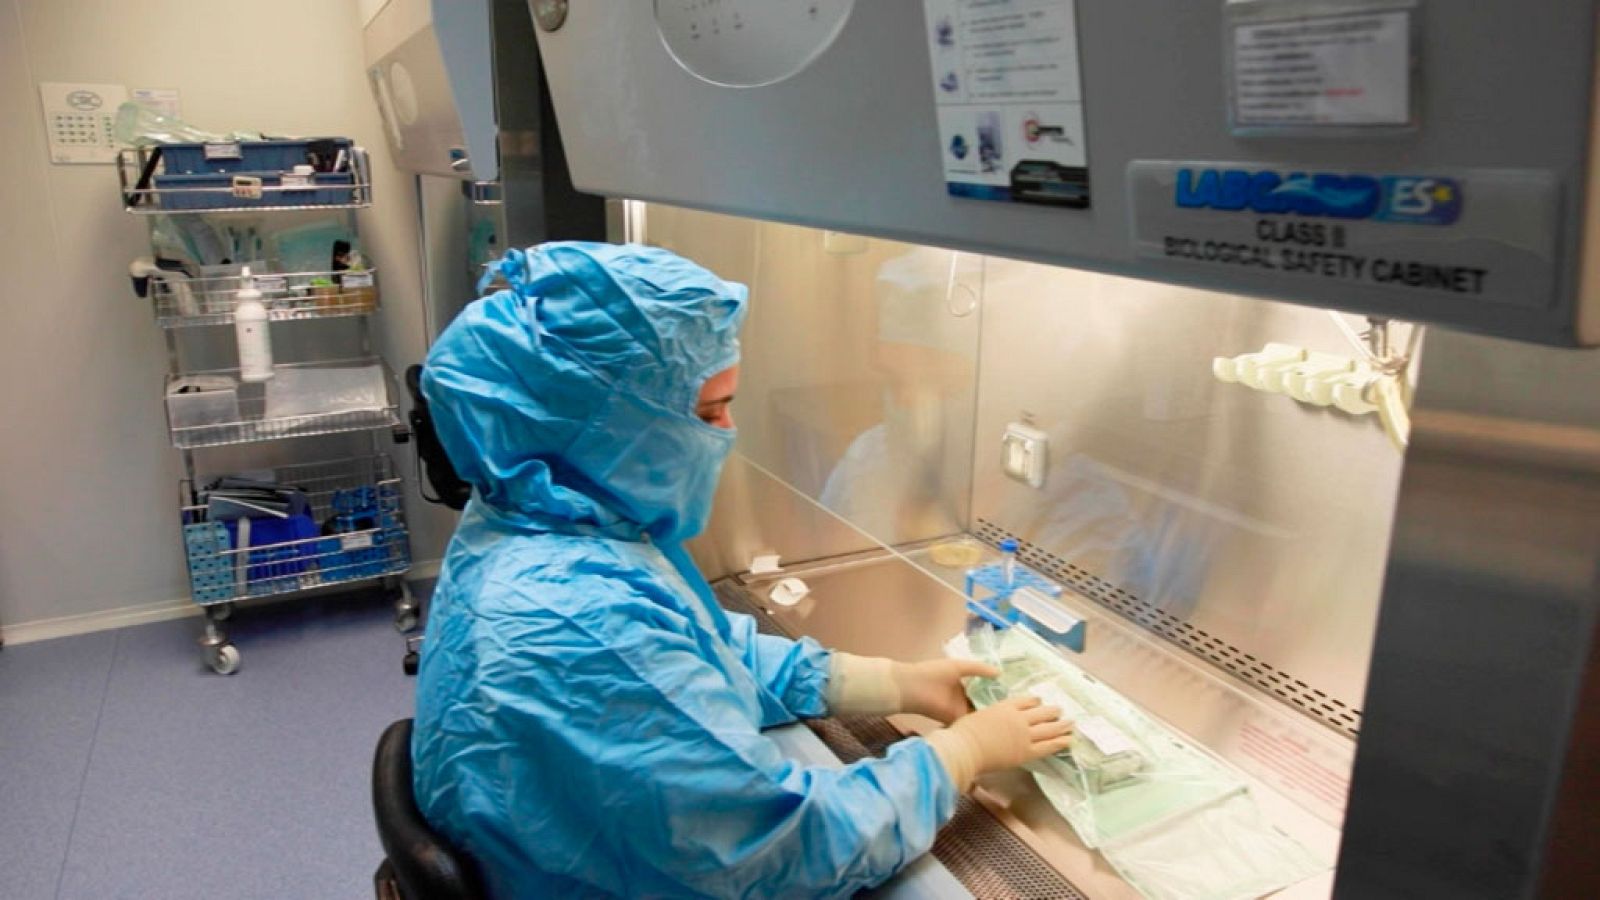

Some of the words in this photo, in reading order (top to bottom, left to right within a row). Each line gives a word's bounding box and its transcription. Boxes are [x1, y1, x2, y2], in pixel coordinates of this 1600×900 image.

[1257, 220, 1326, 247] CLASS
[1164, 236, 1276, 270] BIOLOGICAL
[1281, 249, 1367, 279] SAFETY
[1372, 259, 1488, 294] CABINET
